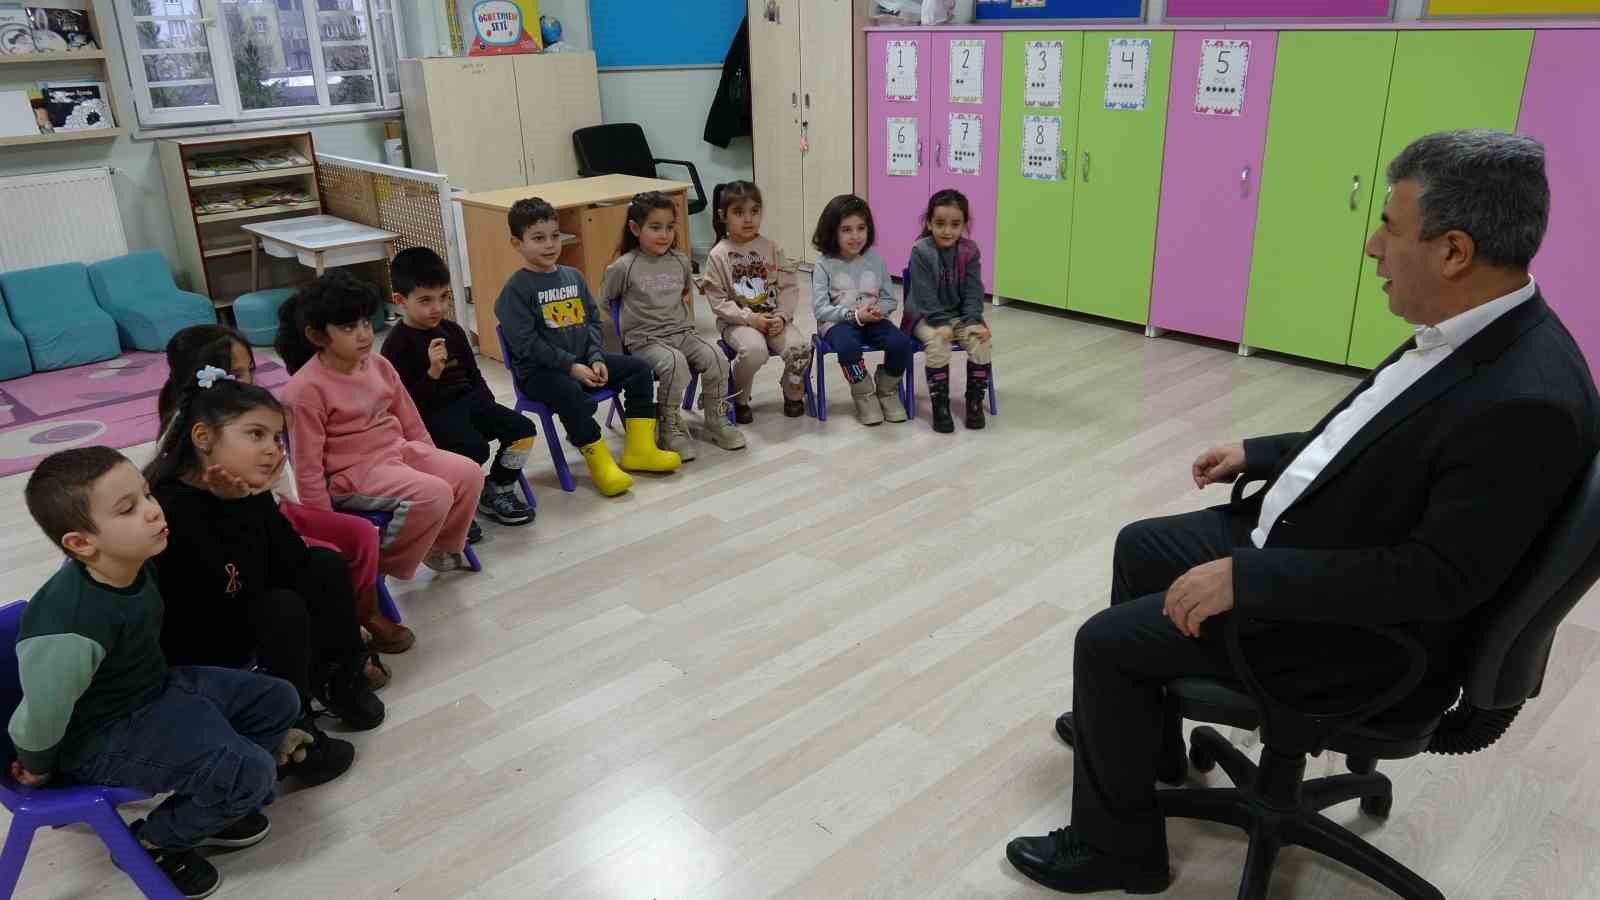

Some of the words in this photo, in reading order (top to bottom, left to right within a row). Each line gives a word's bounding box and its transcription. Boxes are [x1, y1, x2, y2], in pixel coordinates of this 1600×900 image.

[896, 47, 904, 69] 1
[962, 48, 970, 69] 2
[1038, 50, 1047, 71] 3
[1121, 50, 1134, 72] 4
[1216, 50, 1231, 74] 5
[897, 126, 905, 144] 6
[960, 122, 969, 141] 7
[1035, 125, 1044, 145] 8
[537, 284, 578, 304] PIKICHU
